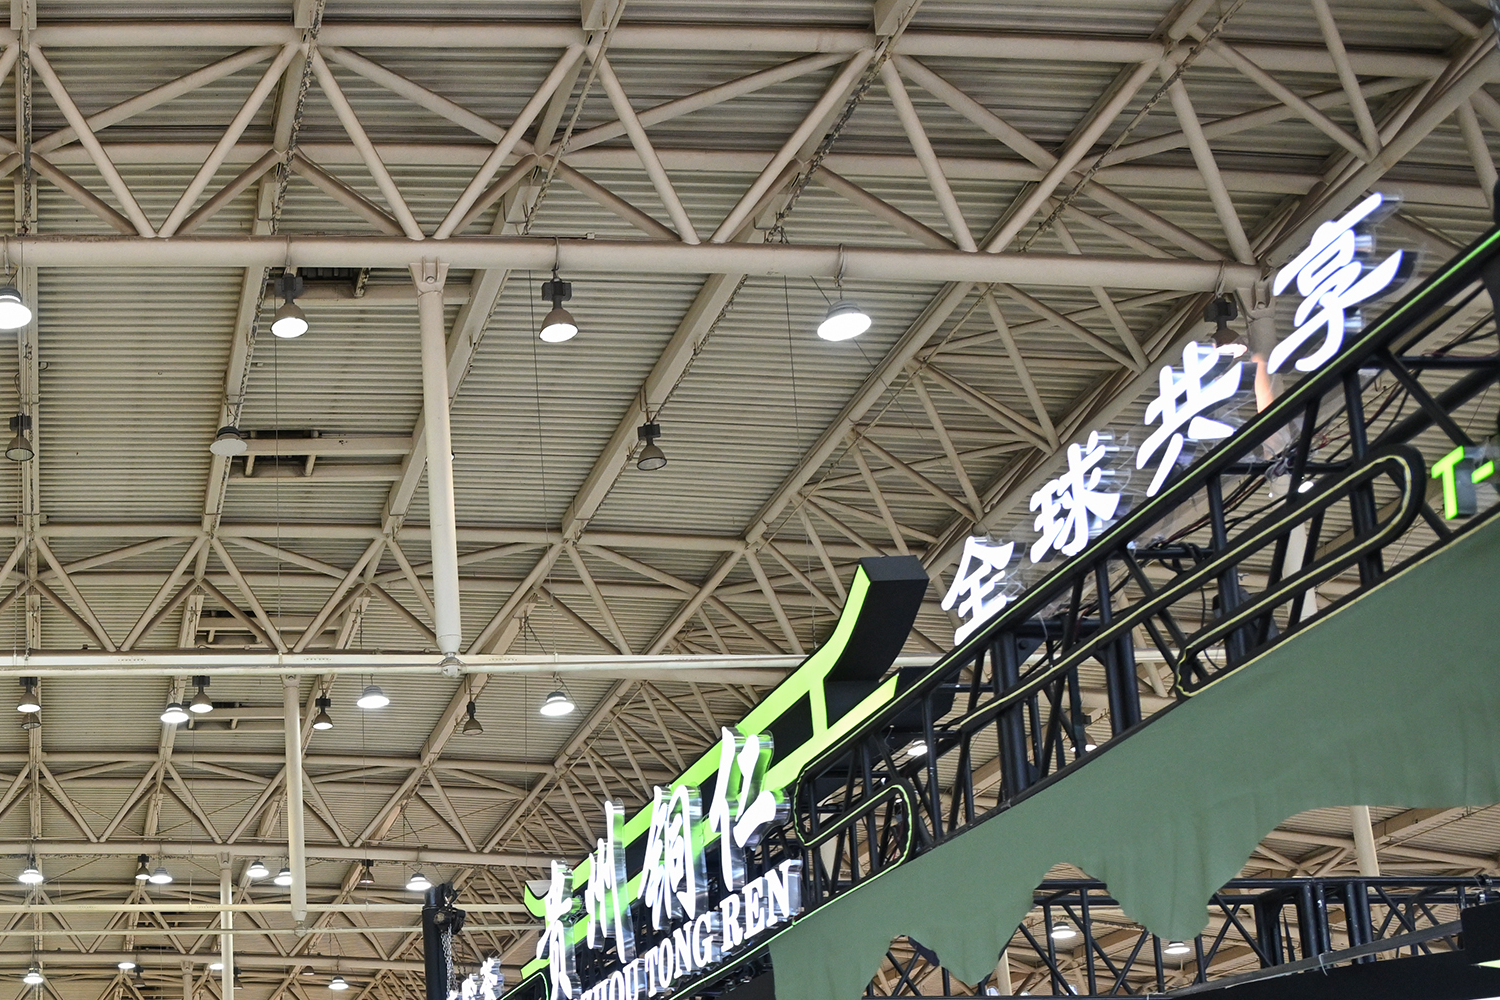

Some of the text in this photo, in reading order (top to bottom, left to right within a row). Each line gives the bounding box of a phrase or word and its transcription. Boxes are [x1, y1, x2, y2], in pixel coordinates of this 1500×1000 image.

[941, 192, 1403, 646] 全球共享
[644, 911, 712, 998] TONG
[720, 859, 792, 953] REN
